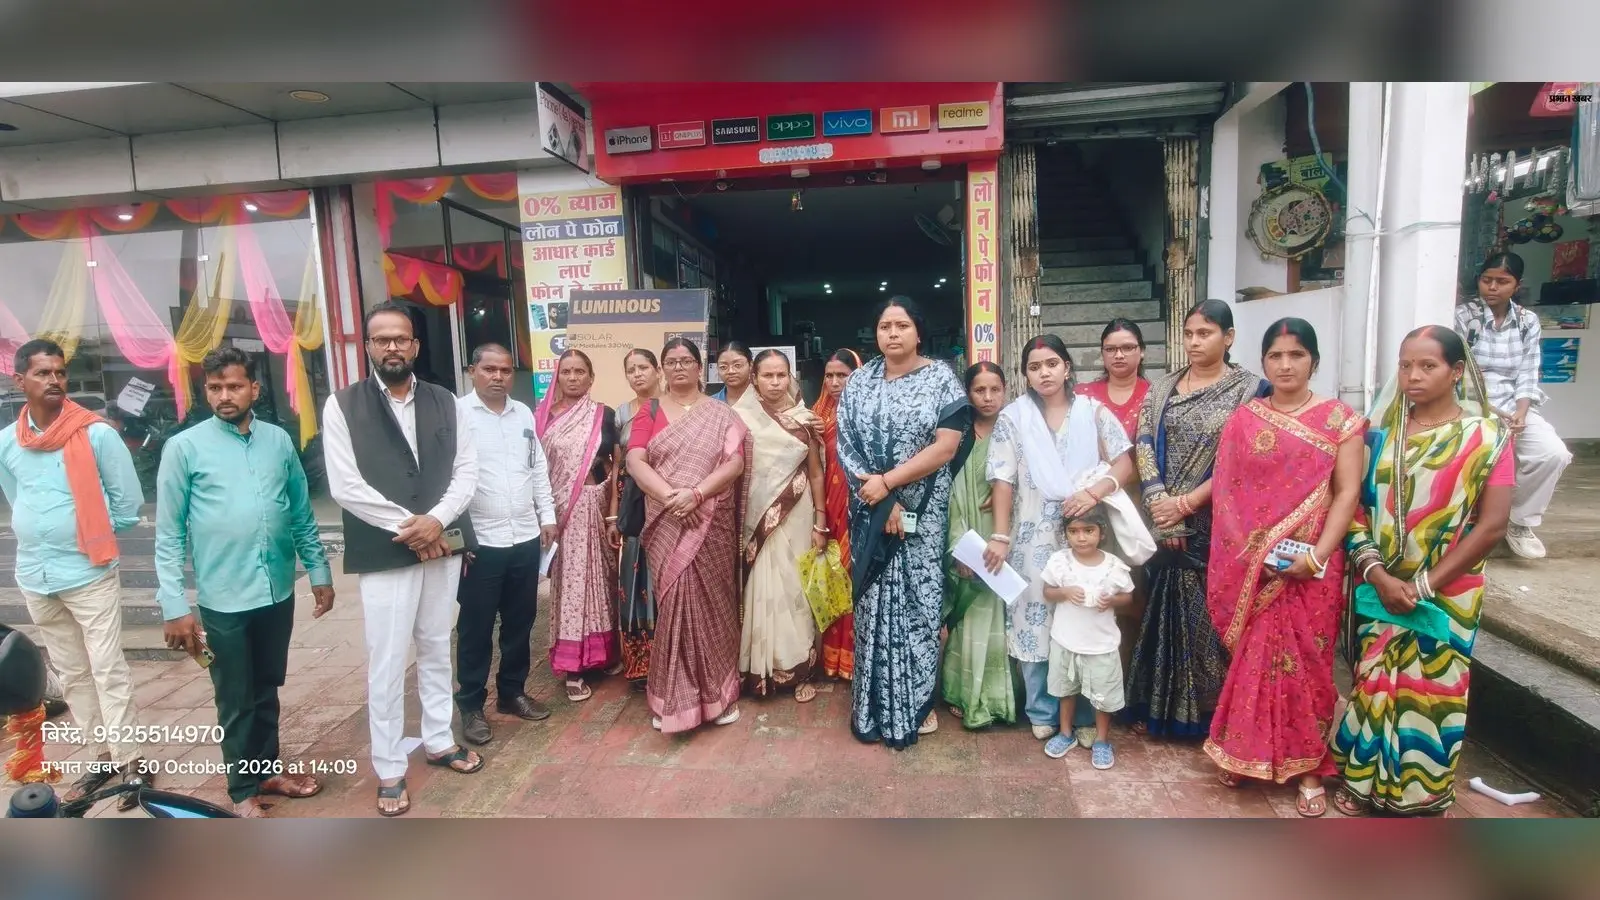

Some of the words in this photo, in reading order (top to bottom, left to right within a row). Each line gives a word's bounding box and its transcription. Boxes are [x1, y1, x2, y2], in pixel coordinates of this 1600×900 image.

[943, 106, 983, 118] realme
[771, 120, 810, 131] oppo
[827, 117, 868, 129] vivo
[715, 126, 756, 136] SAMSUNG
[616, 134, 648, 146] iPhone
[524, 196, 561, 216] 0%
[568, 193, 616, 212] ब्याज
[525, 222, 560, 240] लोन
[565, 220, 577, 237] पे
[582, 219, 619, 236] फोन
[532, 245, 578, 261] आधार
[583, 238, 615, 258] कार्ड
[558, 260, 592, 279] लाएं
[531, 282, 564, 300] फोन
[573, 299, 661, 314] LUMINOUS
[577, 333, 612, 341] SOLAR
[974, 323, 994, 343] 0%
